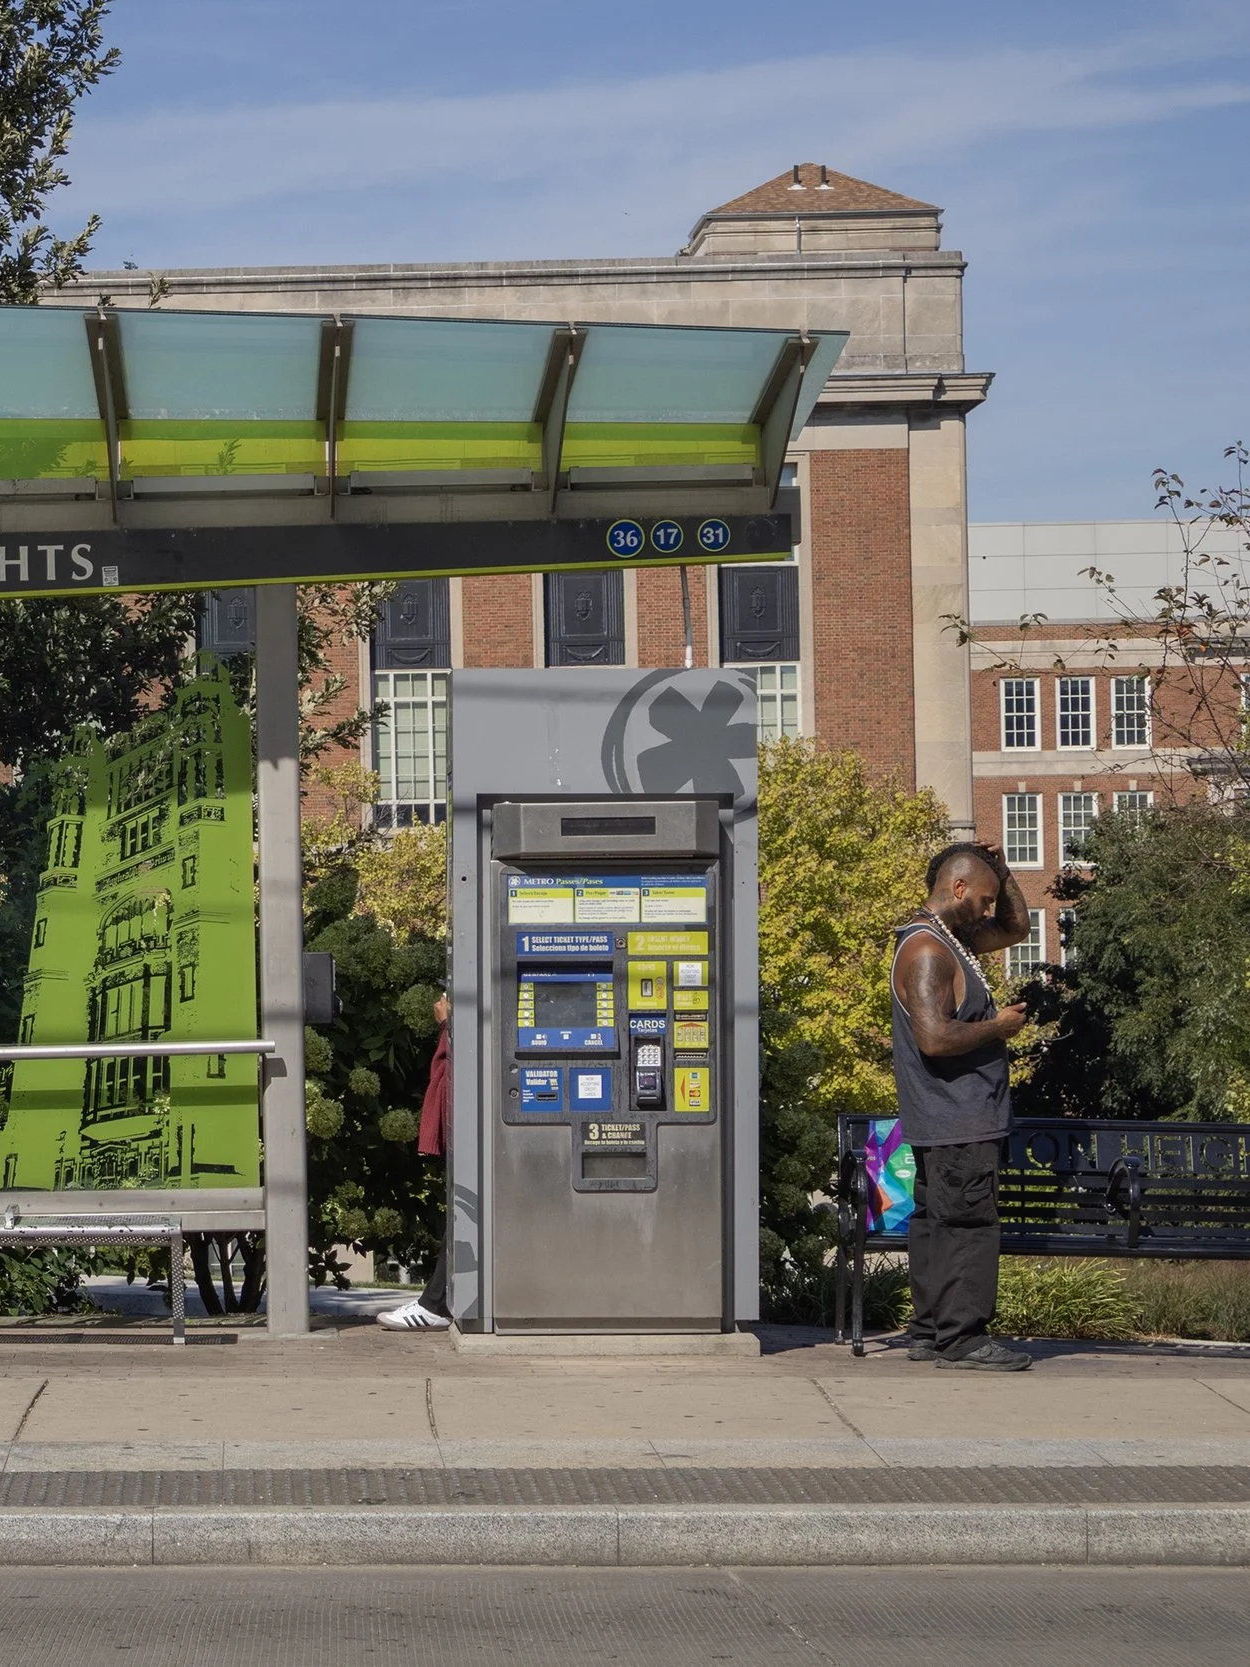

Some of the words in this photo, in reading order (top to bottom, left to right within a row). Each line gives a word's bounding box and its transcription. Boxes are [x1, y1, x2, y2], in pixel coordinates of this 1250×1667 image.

[613, 530, 638, 548] 36
[656, 528, 678, 544] 17
[702, 528, 724, 544] 31
[522, 936, 530, 952] 1
[636, 934, 645, 950] 2
[630, 1020, 666, 1028] CARDS
[589, 1124, 600, 1140] 3
[601, 1124, 640, 1132] TICKET/PASS
